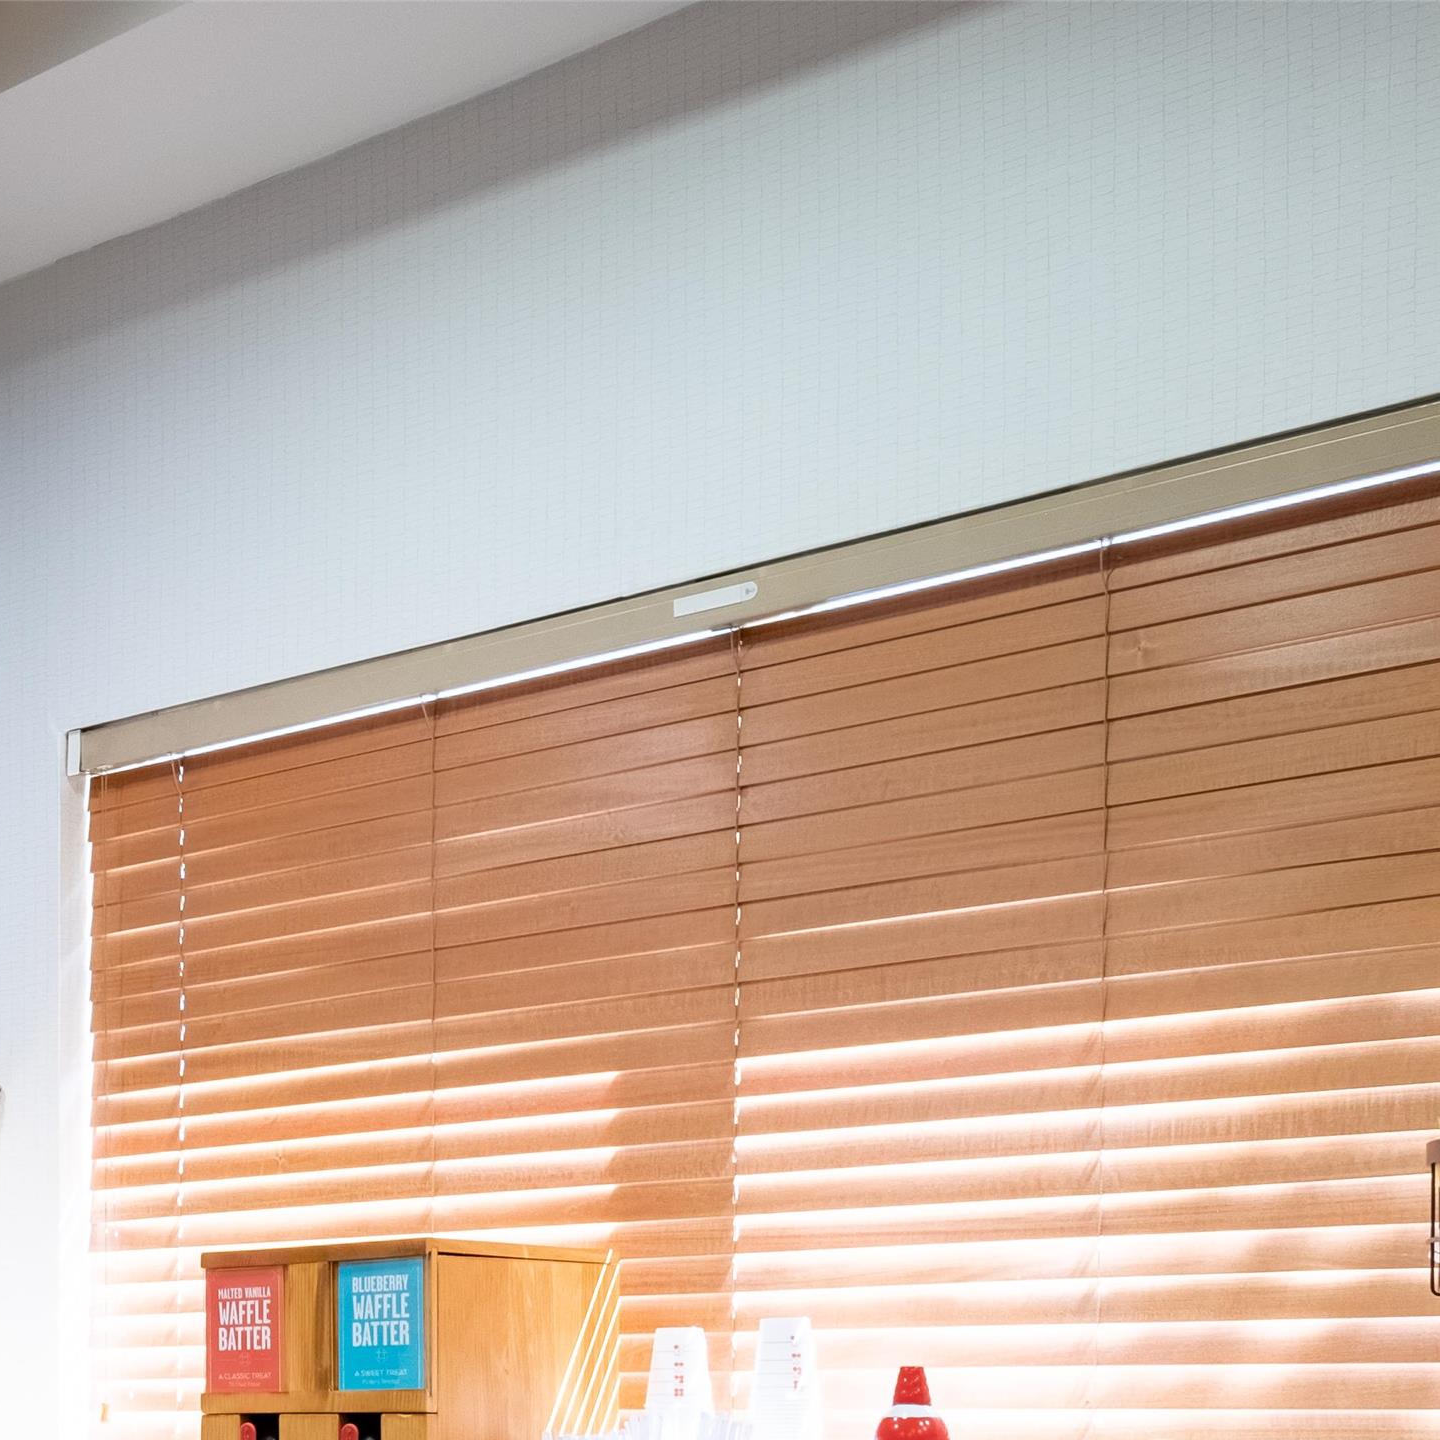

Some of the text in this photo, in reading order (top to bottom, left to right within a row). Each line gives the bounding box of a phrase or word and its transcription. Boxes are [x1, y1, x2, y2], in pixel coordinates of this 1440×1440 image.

[218, 1286, 271, 1300] MALTED VANILLA
[352, 1274, 409, 1293] BLUEBERRY
[218, 1299, 272, 1325] WAFFLE
[352, 1293, 410, 1320] WAFFLE
[218, 1326, 271, 1351] BATTER
[352, 1320, 410, 1347] BATTER
